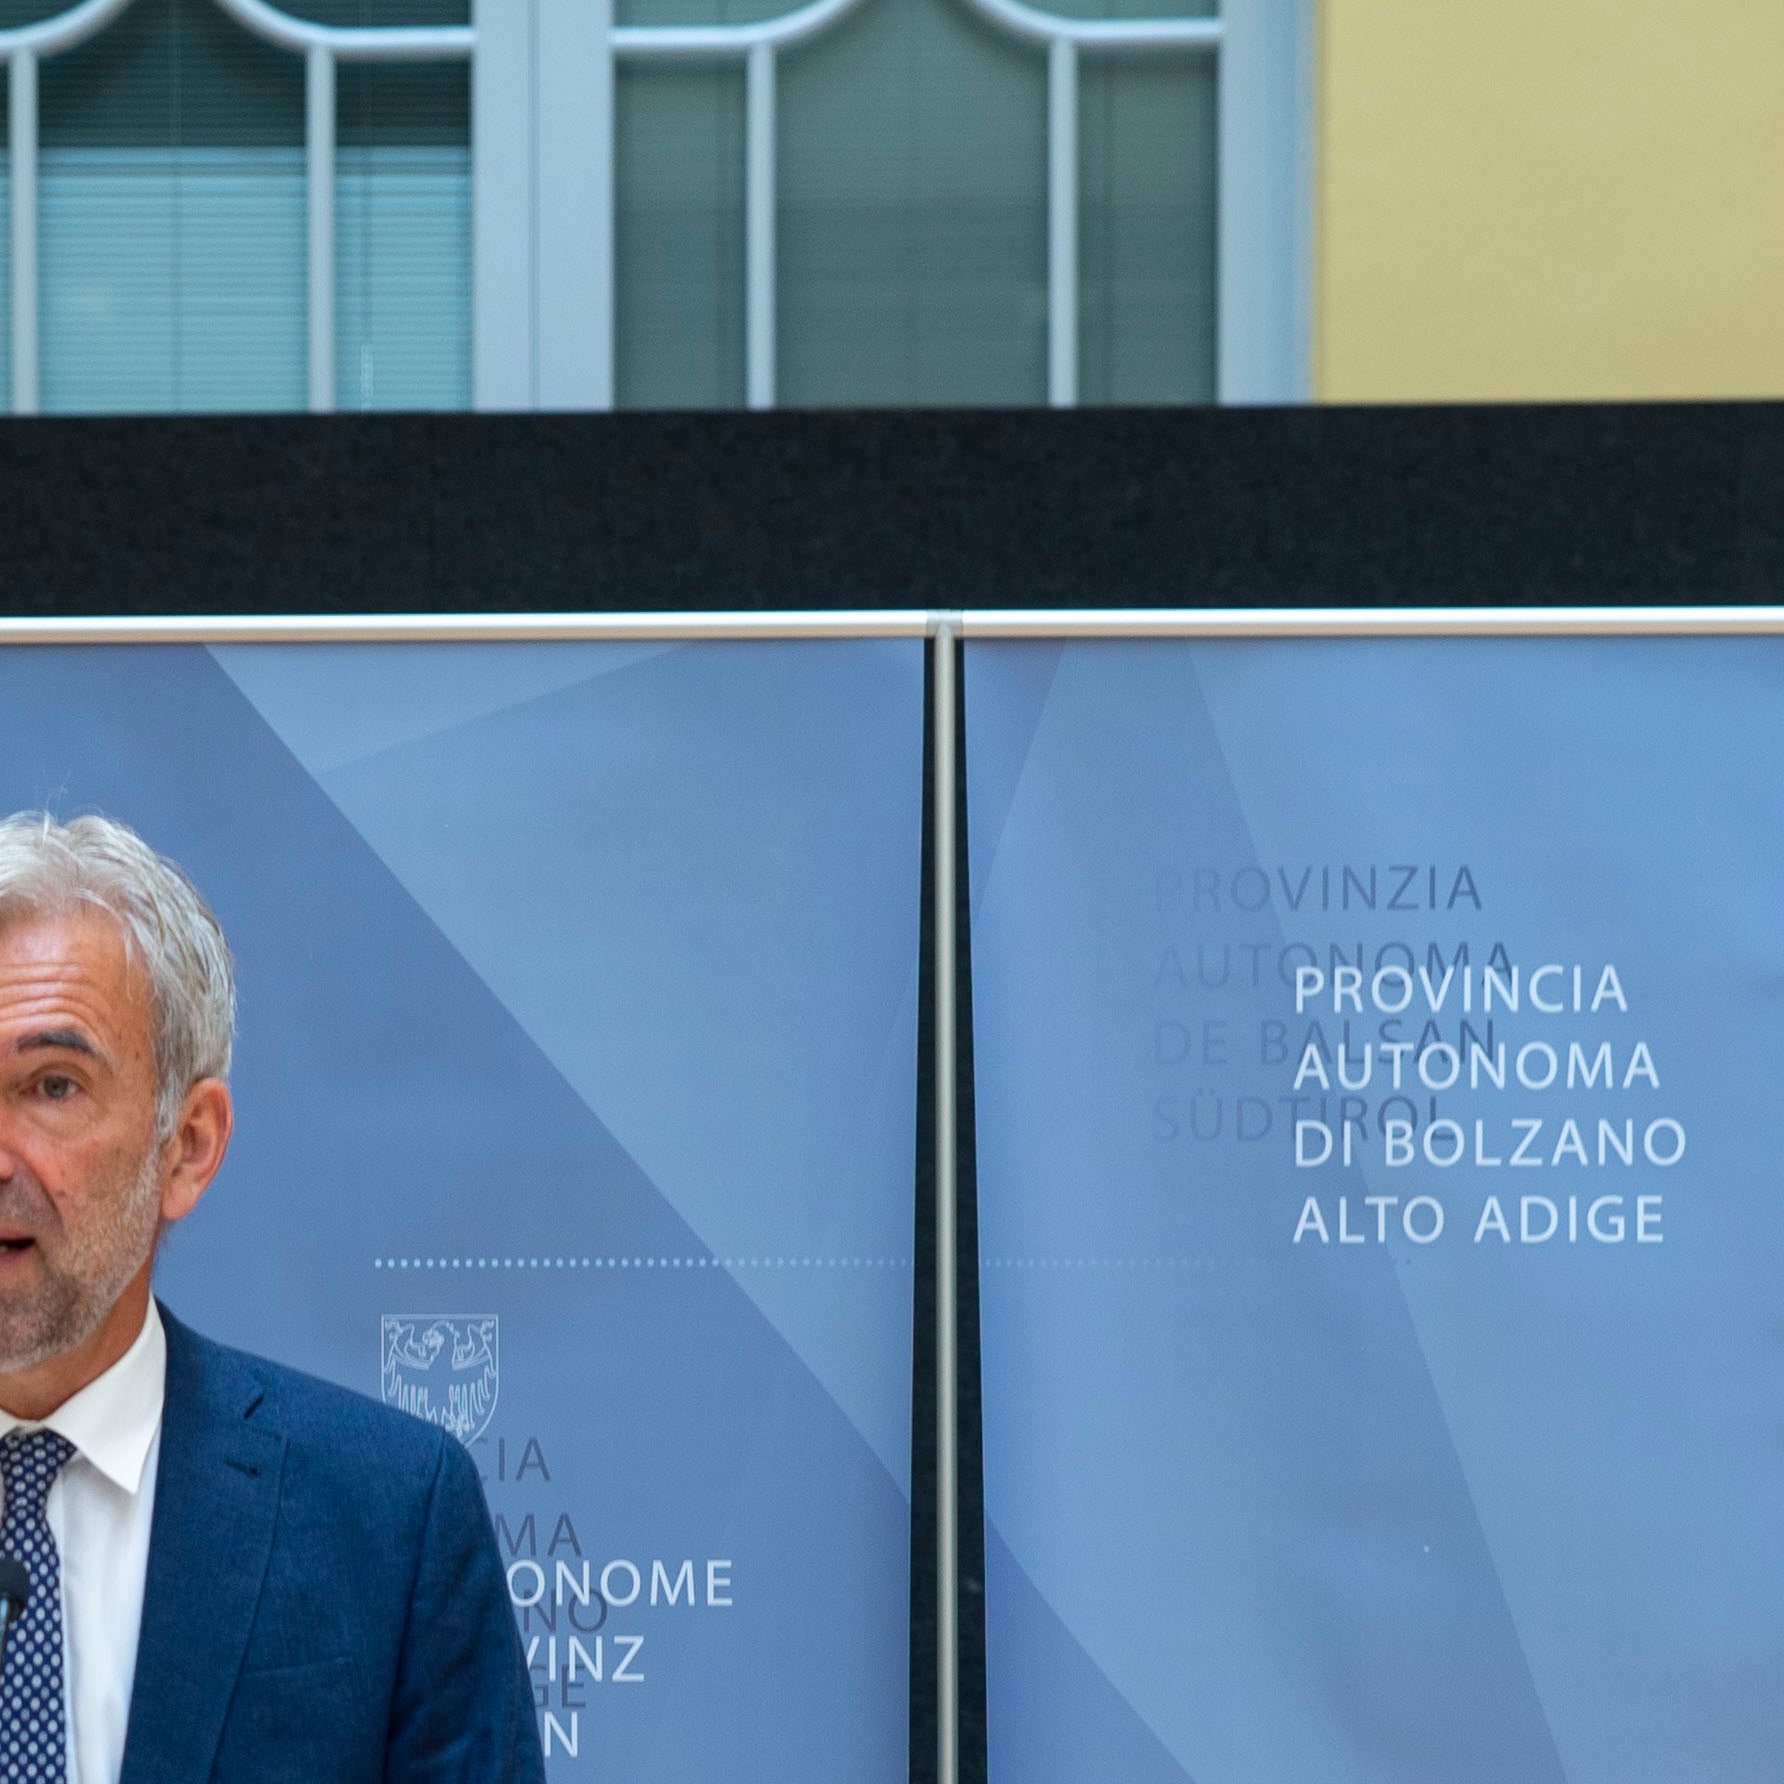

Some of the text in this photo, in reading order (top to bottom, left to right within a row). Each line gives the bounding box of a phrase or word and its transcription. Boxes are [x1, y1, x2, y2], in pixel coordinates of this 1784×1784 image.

[1153, 862, 1485, 913] PROVINZIA
[1152, 939, 1514, 990] AUTONOMA
[1296, 964, 1628, 1013] PROVINCIA
[1153, 1018, 1228, 1067] DE
[1293, 1041, 1661, 1090] AUTONOMA
[1295, 1117, 1686, 1168] DI BOLZANO
[1293, 1195, 1664, 1244] ALTO ADIGE
